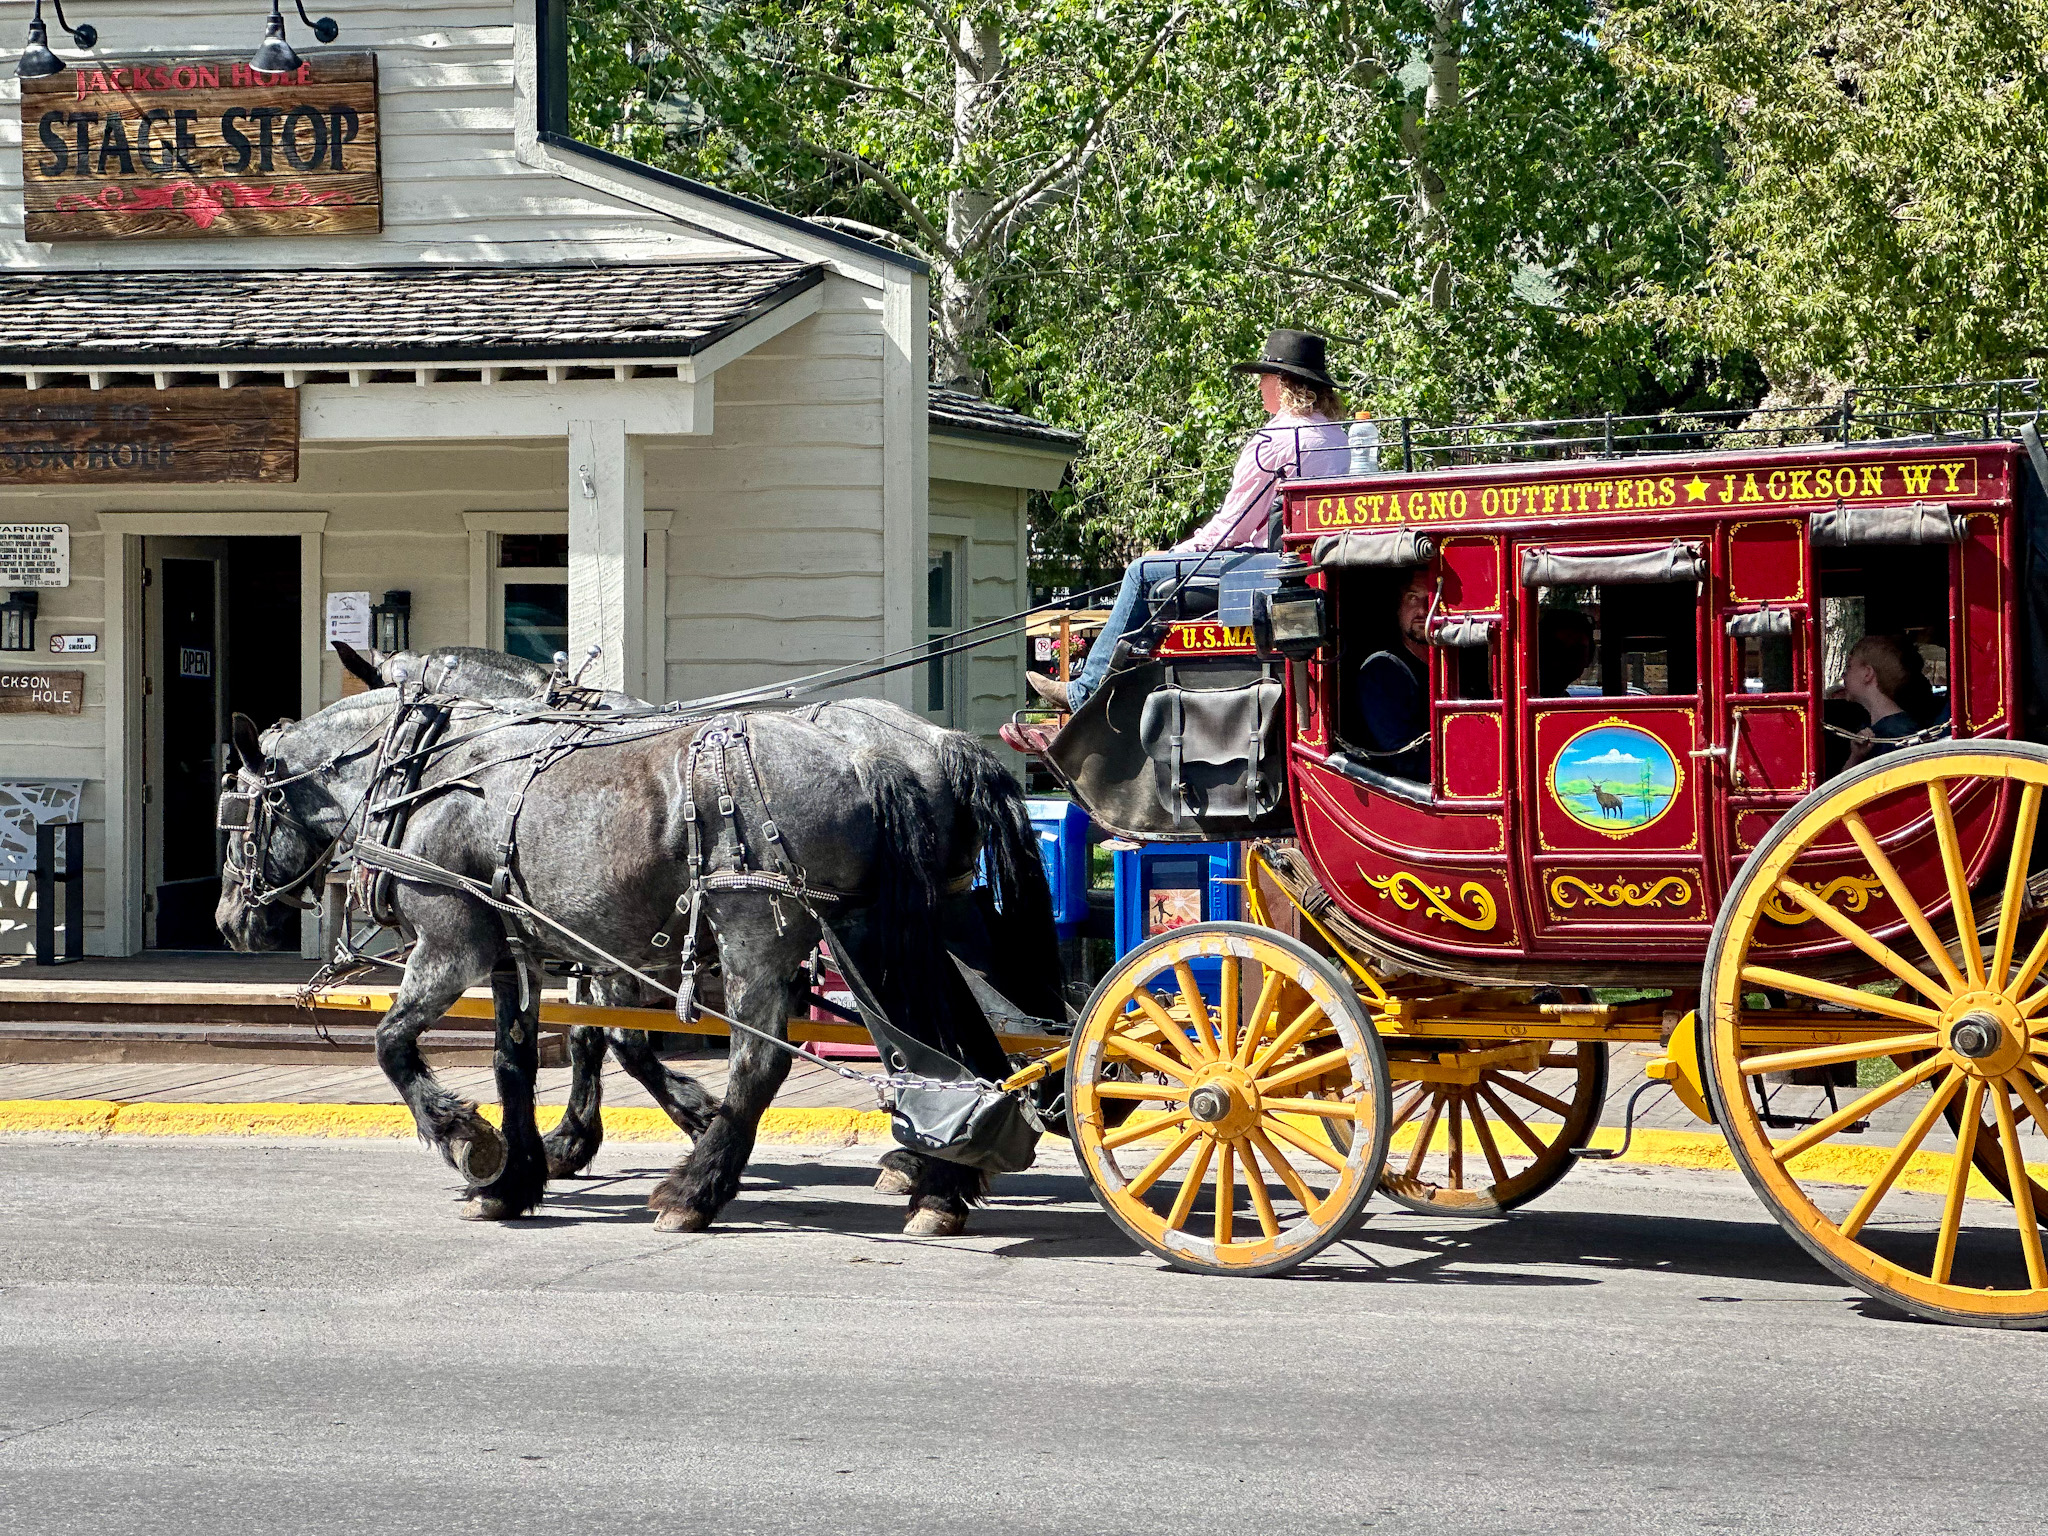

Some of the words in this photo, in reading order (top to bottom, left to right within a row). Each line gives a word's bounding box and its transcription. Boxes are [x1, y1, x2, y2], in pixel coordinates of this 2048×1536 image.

[75, 65, 219, 101] JACKSON
[231, 61, 313, 88] HOLE
[39, 108, 201, 176] STAGE
[221, 105, 359, 173] STOP
[88, 439, 175, 471] HOLE
[1318, 489, 1467, 526] CASTAGNO
[1481, 477, 1676, 516] OUTFITTERS
[1718, 466, 1885, 504] JACKSON
[1898, 463, 1966, 495] WY
[1182, 626, 1256, 648] U.S.MA
[182, 649, 208, 675] OPEN
[32, 690, 72, 704] HOLE
